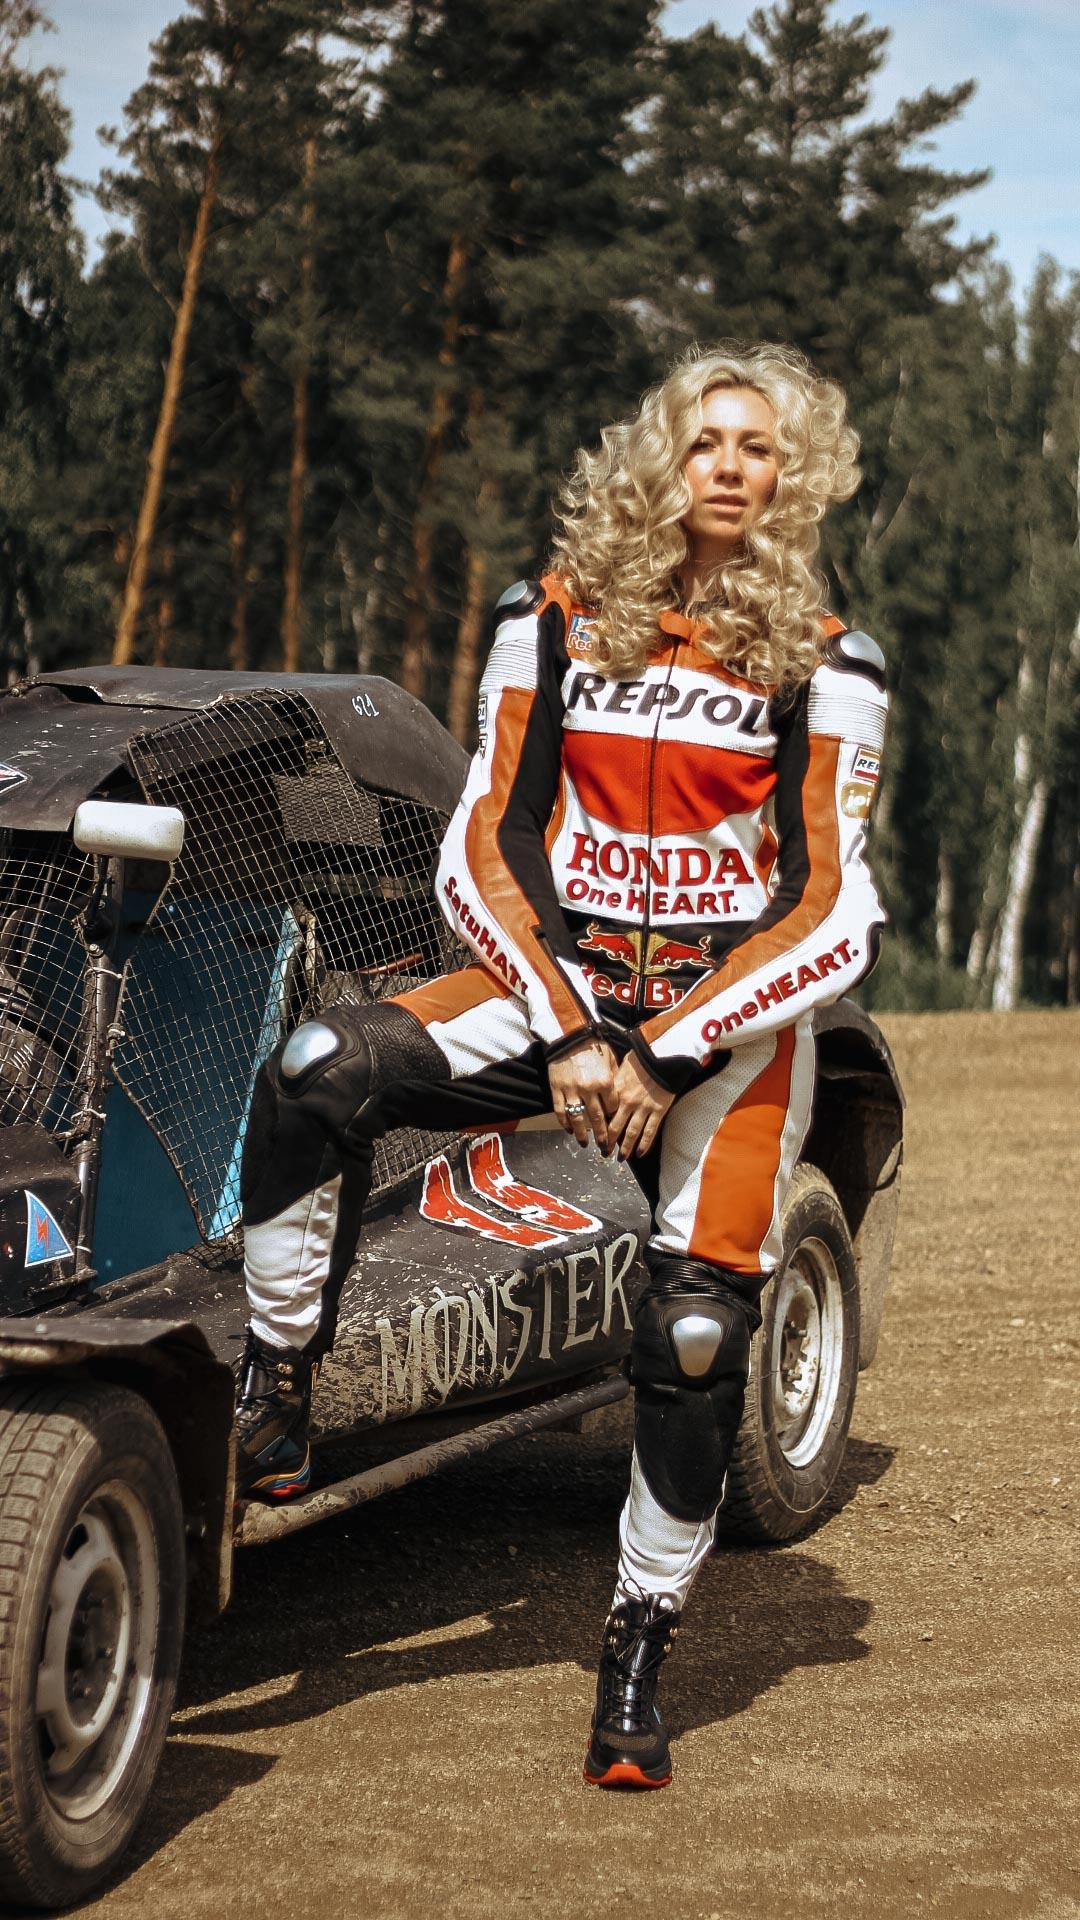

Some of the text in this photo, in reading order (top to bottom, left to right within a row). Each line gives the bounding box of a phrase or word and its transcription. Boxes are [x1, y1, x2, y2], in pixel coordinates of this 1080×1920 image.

[566, 672, 766, 737] REPSOL
[566, 832, 755, 887] HONDA
[375, 1232, 638, 1423] MONSTER
